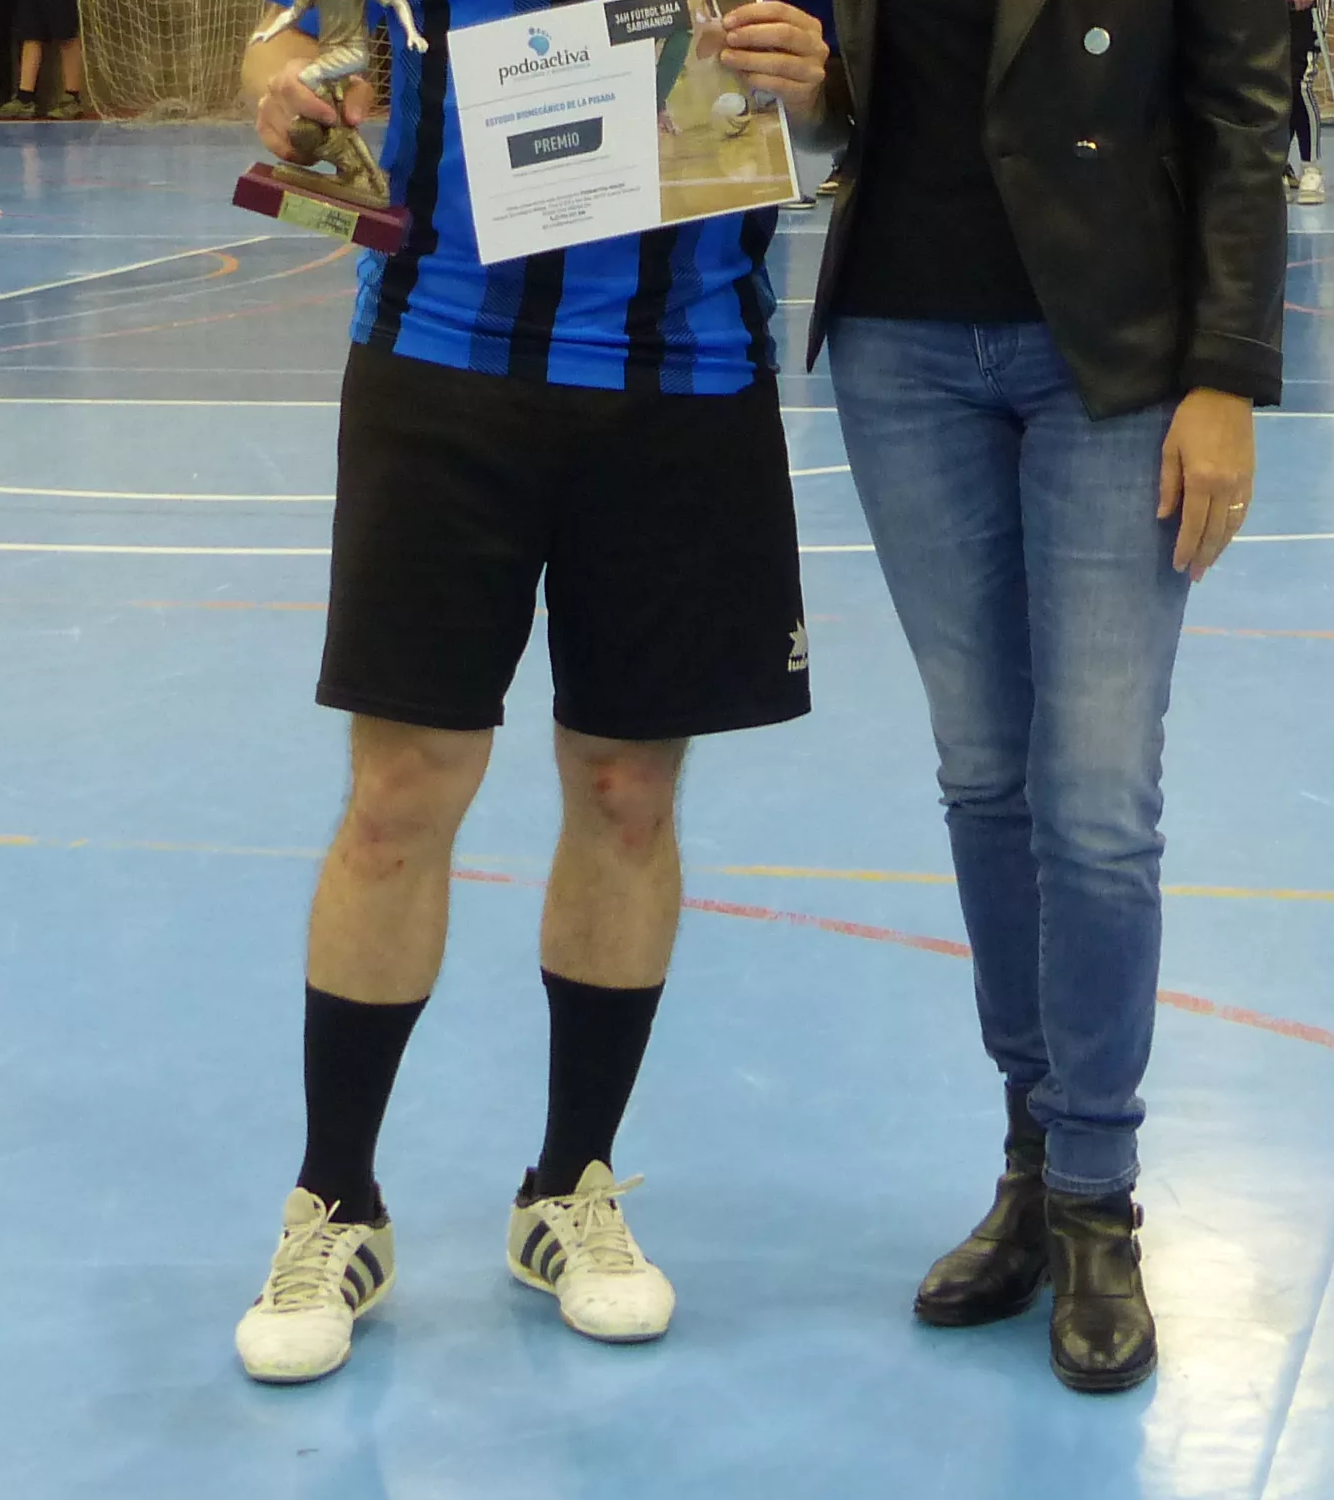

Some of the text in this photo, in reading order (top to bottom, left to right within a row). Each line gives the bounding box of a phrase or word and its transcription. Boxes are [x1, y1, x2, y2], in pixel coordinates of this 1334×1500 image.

[660, 1, 681, 16] SALA
[498, 47, 590, 86] podoactiva
[588, 92, 616, 105] PISADA
[534, 131, 580, 155] PREMIO
